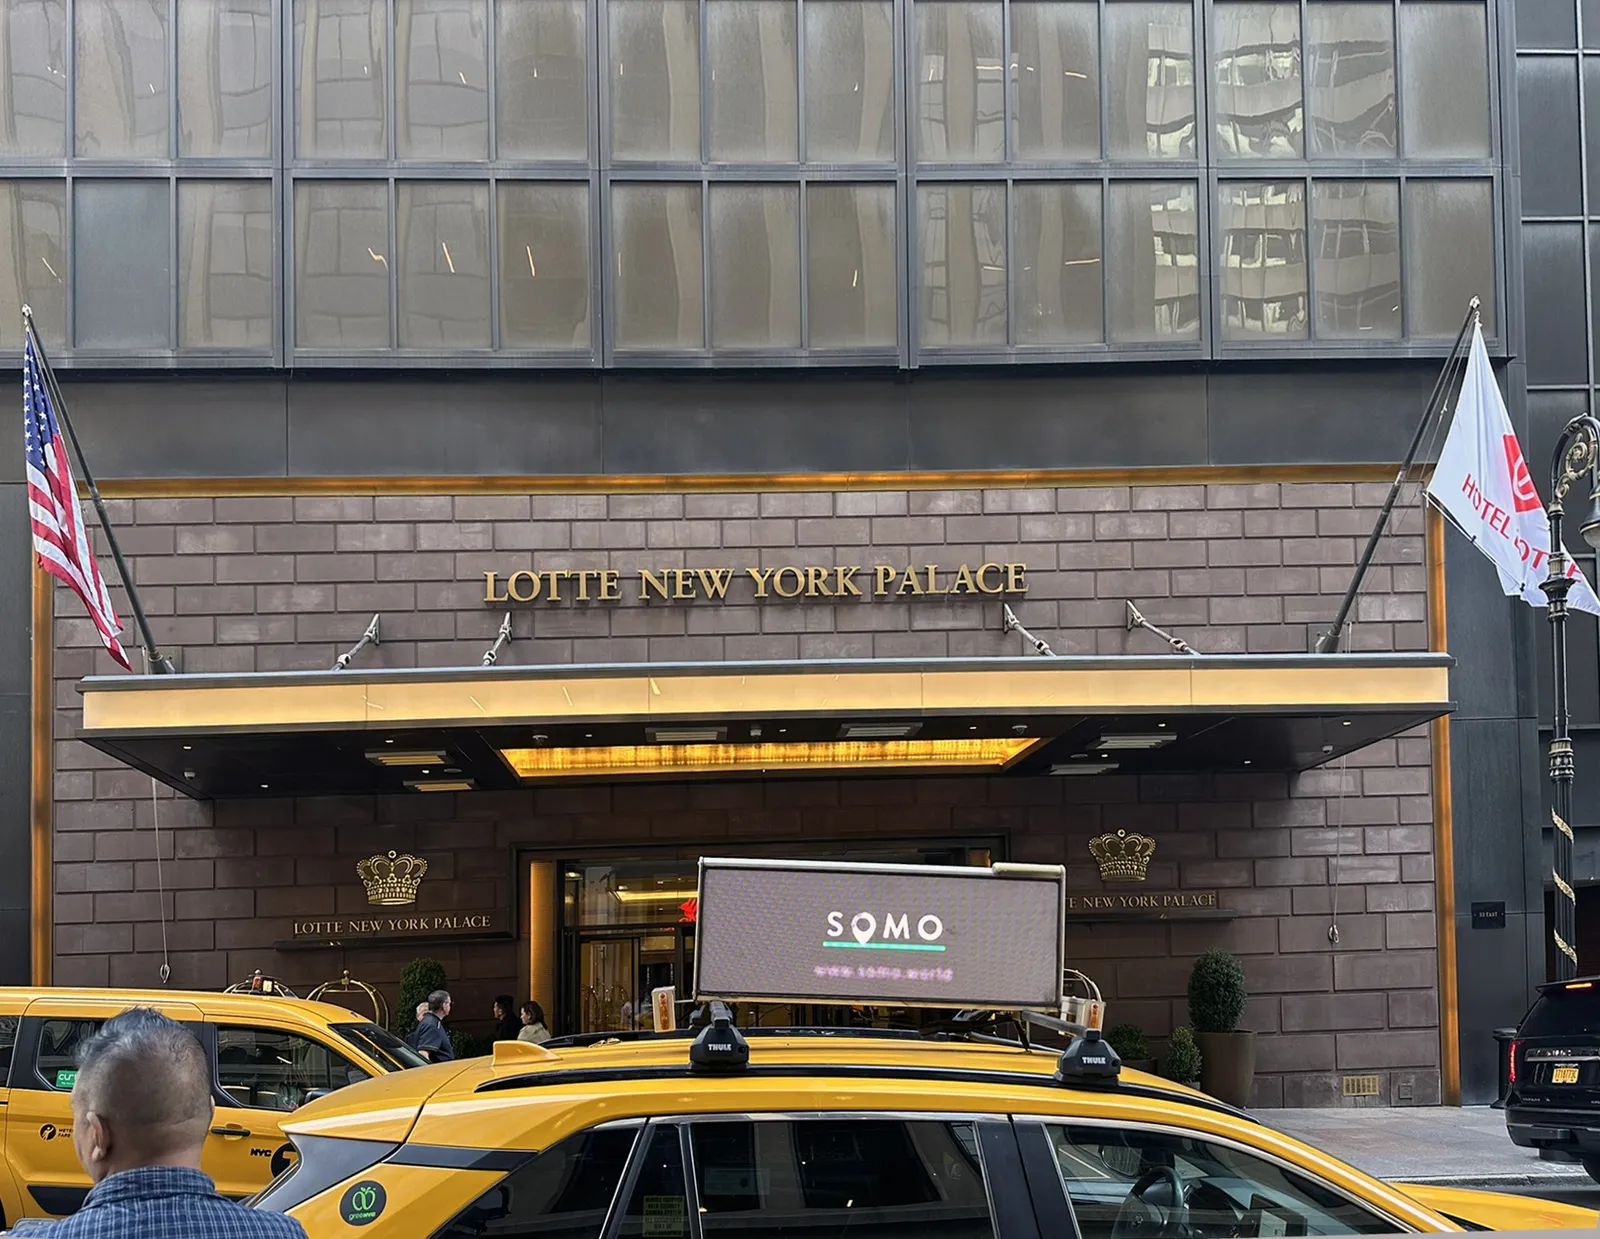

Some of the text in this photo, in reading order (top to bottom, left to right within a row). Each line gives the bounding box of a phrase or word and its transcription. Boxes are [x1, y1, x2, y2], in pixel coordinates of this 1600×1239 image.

[1461, 473, 1511, 540] HOTEL
[483, 563, 1030, 602] LOTTE NEW YORK PALACE
[1083, 896, 1116, 909] NEW
[1120, 895, 1159, 908] YORK
[1163, 893, 1216, 907] PALACE
[293, 914, 491, 935] LOTTE NEW YORK PALACE
[827, 911, 943, 945] SOMO
[708, 1043, 732, 1051] THULE
[1081, 1056, 1106, 1065] THULE
[58, 1073, 77, 1081] cur
[250, 1148, 272, 1157] NYC
